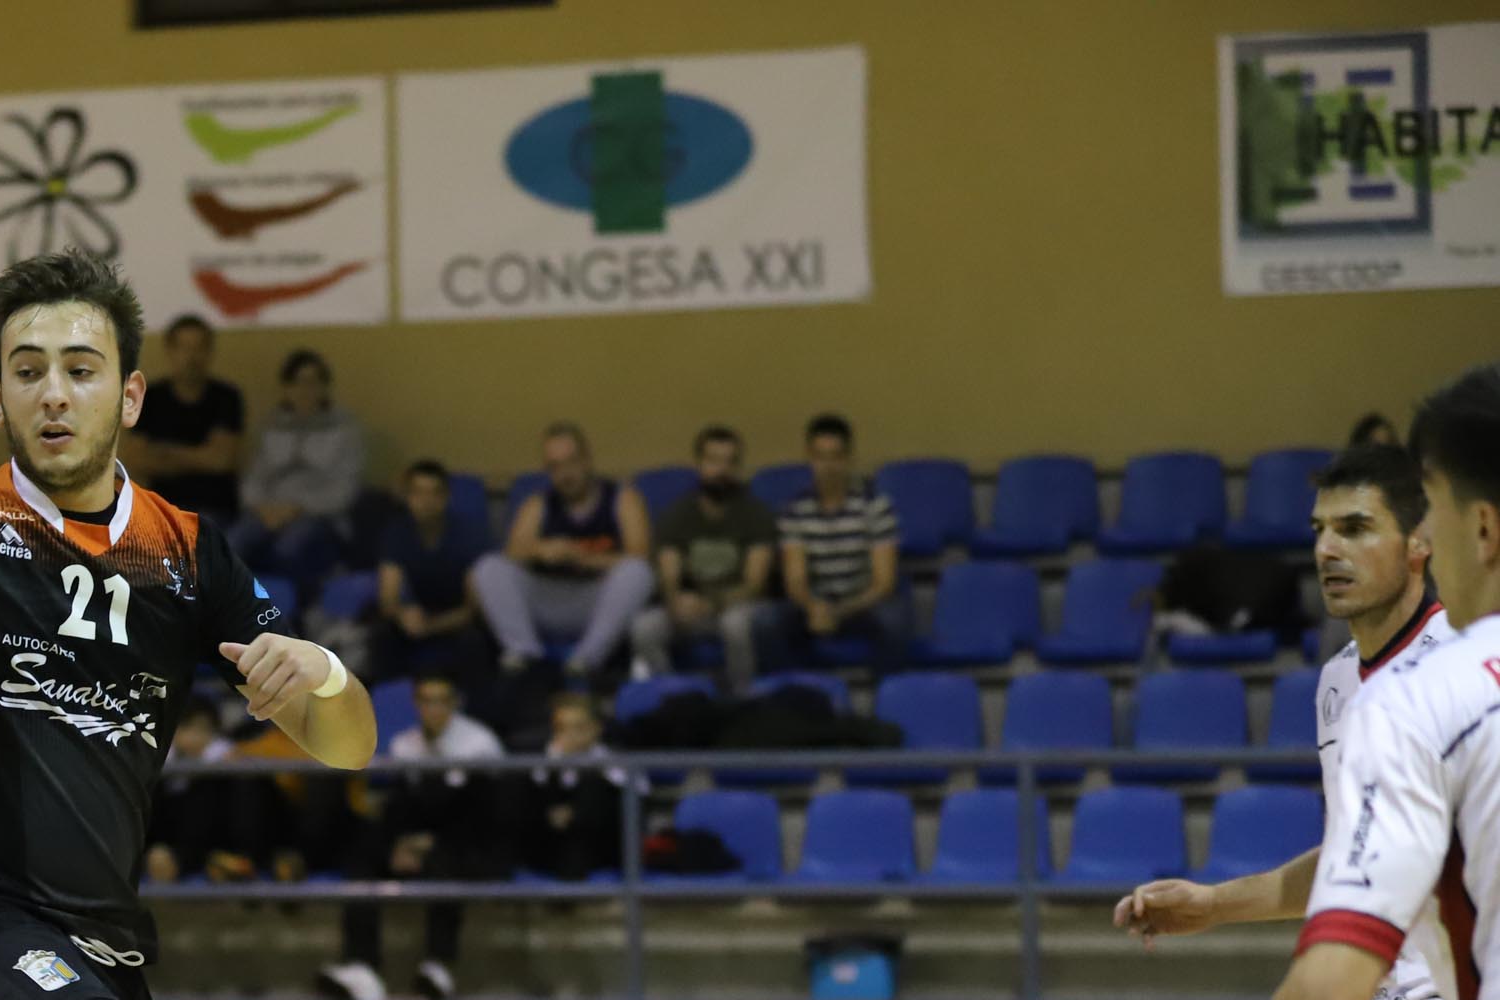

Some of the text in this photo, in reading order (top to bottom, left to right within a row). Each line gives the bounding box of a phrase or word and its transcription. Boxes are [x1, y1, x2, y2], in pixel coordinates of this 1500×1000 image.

[439, 240, 826, 308] CONGESA XXI
[57, 563, 131, 646] 21
